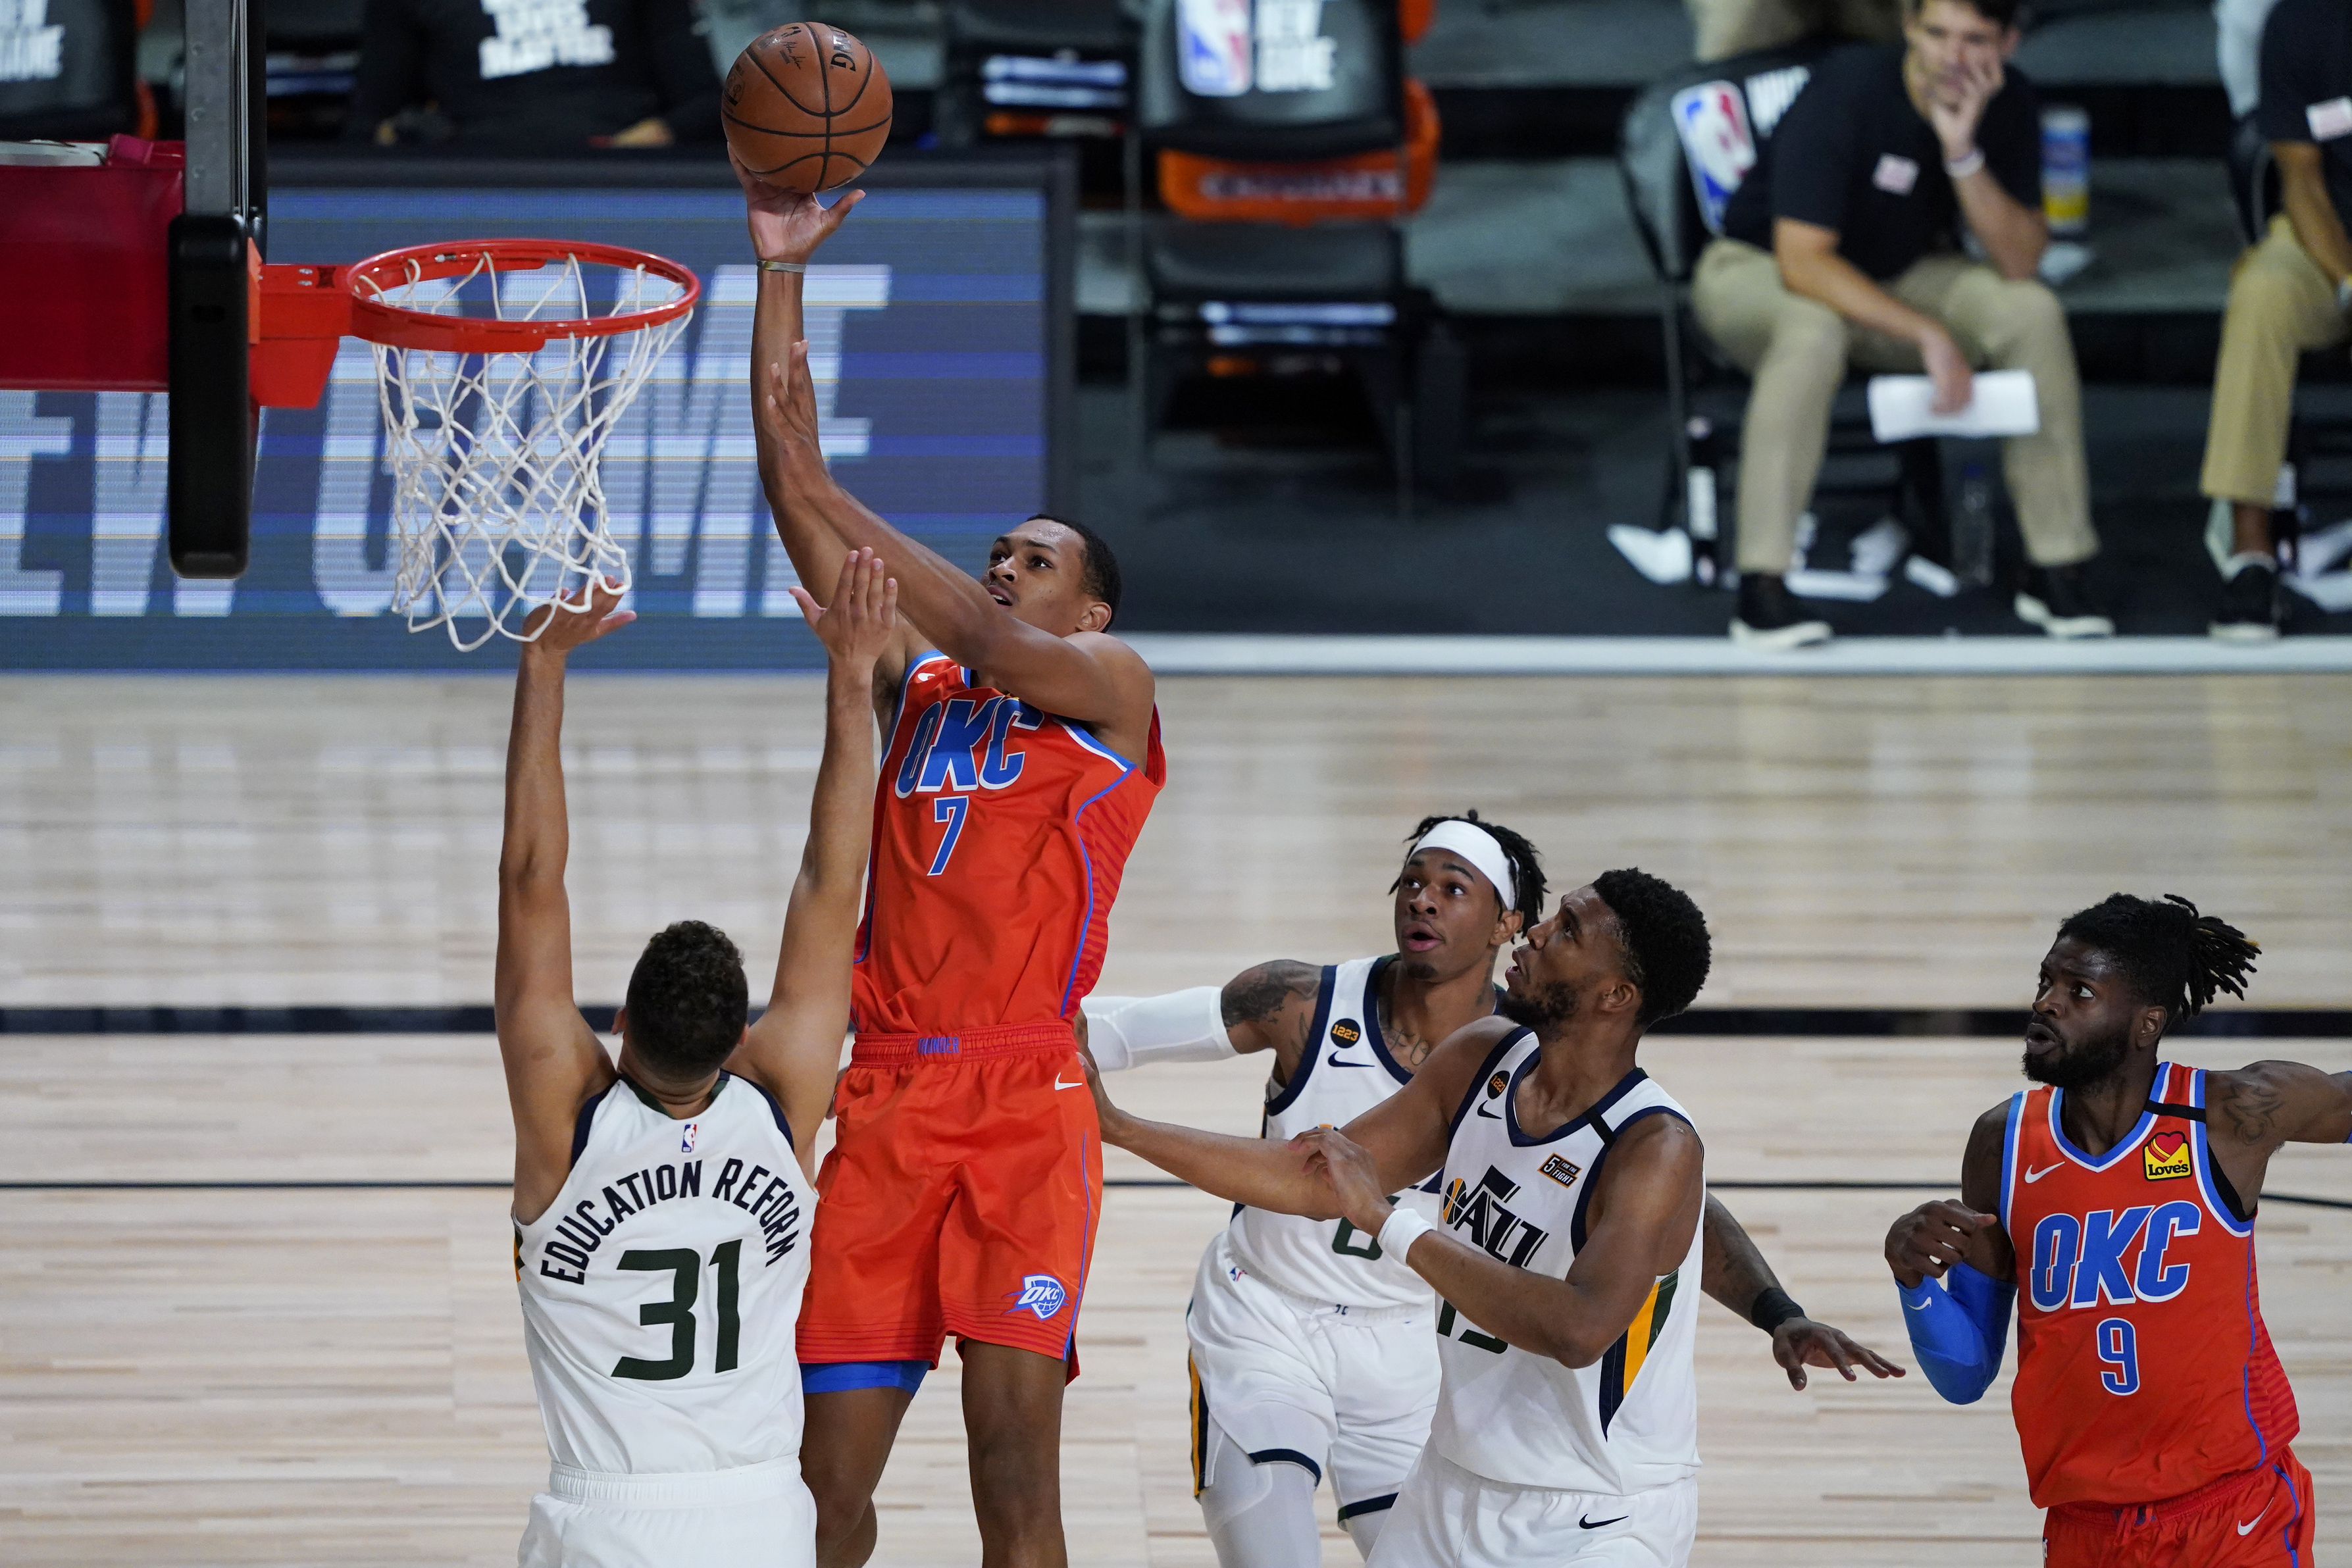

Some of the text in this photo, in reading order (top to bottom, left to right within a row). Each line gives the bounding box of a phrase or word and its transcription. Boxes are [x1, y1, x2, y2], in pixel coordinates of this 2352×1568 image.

[313, 264, 893, 617] GAME
[894, 695, 1045, 799] OKC
[927, 795, 969, 876] 7
[917, 1036, 959, 1055] THUNDER
[1332, 1024, 1359, 1042] 1223
[1490, 1075, 1506, 1093] 1223
[1543, 1156, 1560, 1173] 5
[1552, 1169, 1573, 1184] FIGHT
[540, 1158, 800, 1285] EDUCATION REFORM
[2030, 1200, 2202, 1313] OKC
[611, 1238, 743, 1381] 31
[1018, 1286, 1060, 1305] OKC
[2095, 1317, 2141, 1396] 9
